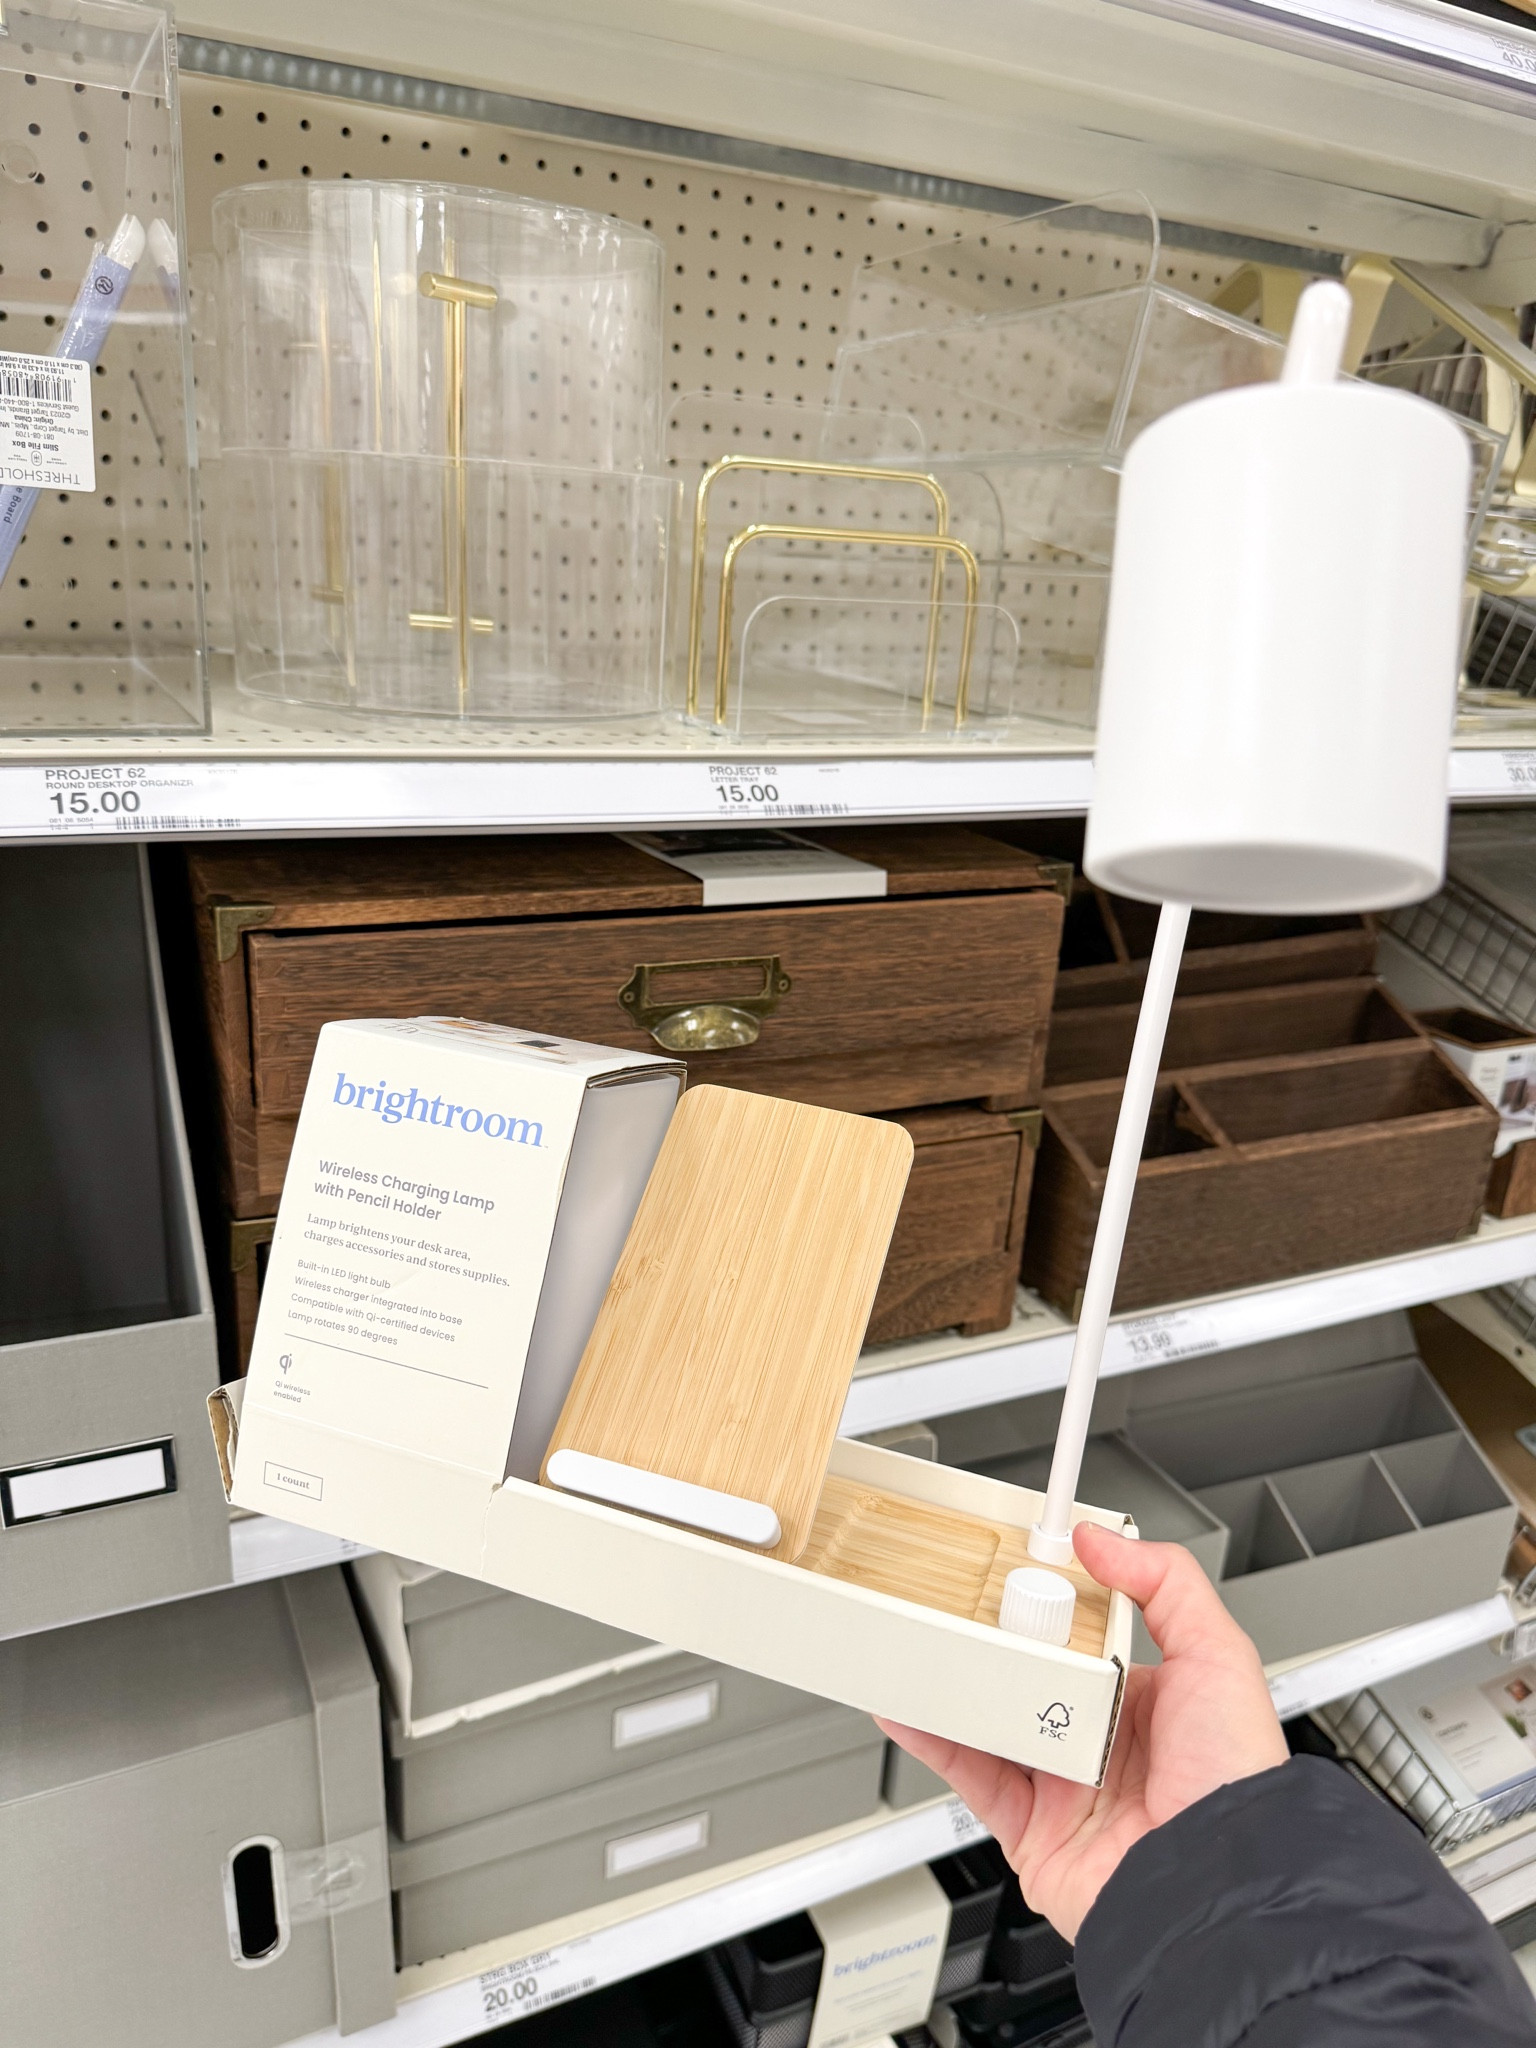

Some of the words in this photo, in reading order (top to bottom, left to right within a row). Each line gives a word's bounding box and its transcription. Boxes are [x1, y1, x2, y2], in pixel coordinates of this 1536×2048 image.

[0, 398, 35, 407] 1-800-440-
[37, 402, 60, 410] Services
[31, 409, 49, 417] Target
[48, 426, 66, 434] Target
[12, 440, 26, 448] Box
[28, 441, 41, 450] File
[43, 443, 59, 451] Slim
[4, 495, 22, 524] Board
[45, 768, 123, 780] PROJECT
[128, 768, 146, 778] 62
[709, 766, 760, 776] PROJECT
[764, 766, 778, 776] 62
[46, 782, 85, 790] ROUND
[88, 780, 137, 789] DESKTOP
[716, 784, 779, 802] 15.00
[50, 790, 140, 814] 15.00
[333, 1072, 544, 1148] brightroom
[318, 1160, 378, 1184] Wireless
[382, 1174, 450, 1204] Charging
[452, 1190, 495, 1214] Lamp
[314, 1182, 344, 1198] with
[347, 1188, 390, 1209] Pencil
[393, 1199, 442, 1220] Holder
[307, 1213, 337, 1229] Lamp
[339, 1220, 389, 1241] brightens
[390, 1234, 416, 1246] your
[418, 1240, 442, 1254] desk
[444, 1248, 471, 1262] area,
[304, 1230, 344, 1246] charges
[345, 1240, 404, 1261] accessories
[406, 1255, 426, 1267] and
[429, 1261, 461, 1275] stores
[462, 1268, 510, 1287] supplies.
[298, 1259, 330, 1274] Built-in
[331, 1268, 346, 1278] LED
[348, 1272, 368, 1284] light
[370, 1276, 391, 1289] bulb
[294, 1276, 331, 1292] Wireless
[333, 1286, 369, 1301] charger
[371, 1294, 418, 1314] integrated
[420, 1307, 438, 1319] into
[440, 1312, 463, 1326] base
[291, 1293, 343, 1313] Compatible
[345, 1308, 364, 1319] with
[366, 1312, 418, 1332] Qi-certified
[419, 1326, 455, 1342] devices
[287, 1310, 313, 1324] Lamp
[314, 1316, 346, 1332] rotates
[348, 1325, 359, 1335] 90
[360, 1329, 398, 1345] degrees
[275, 1380, 283, 1388] Qi
[283, 1384, 311, 1396] wireless
[274, 1390, 301, 1403] enabled
[282, 1476, 310, 1489] count
[1039, 1726, 1067, 1741] FSC
[484, 1976, 538, 2012] 20.00
